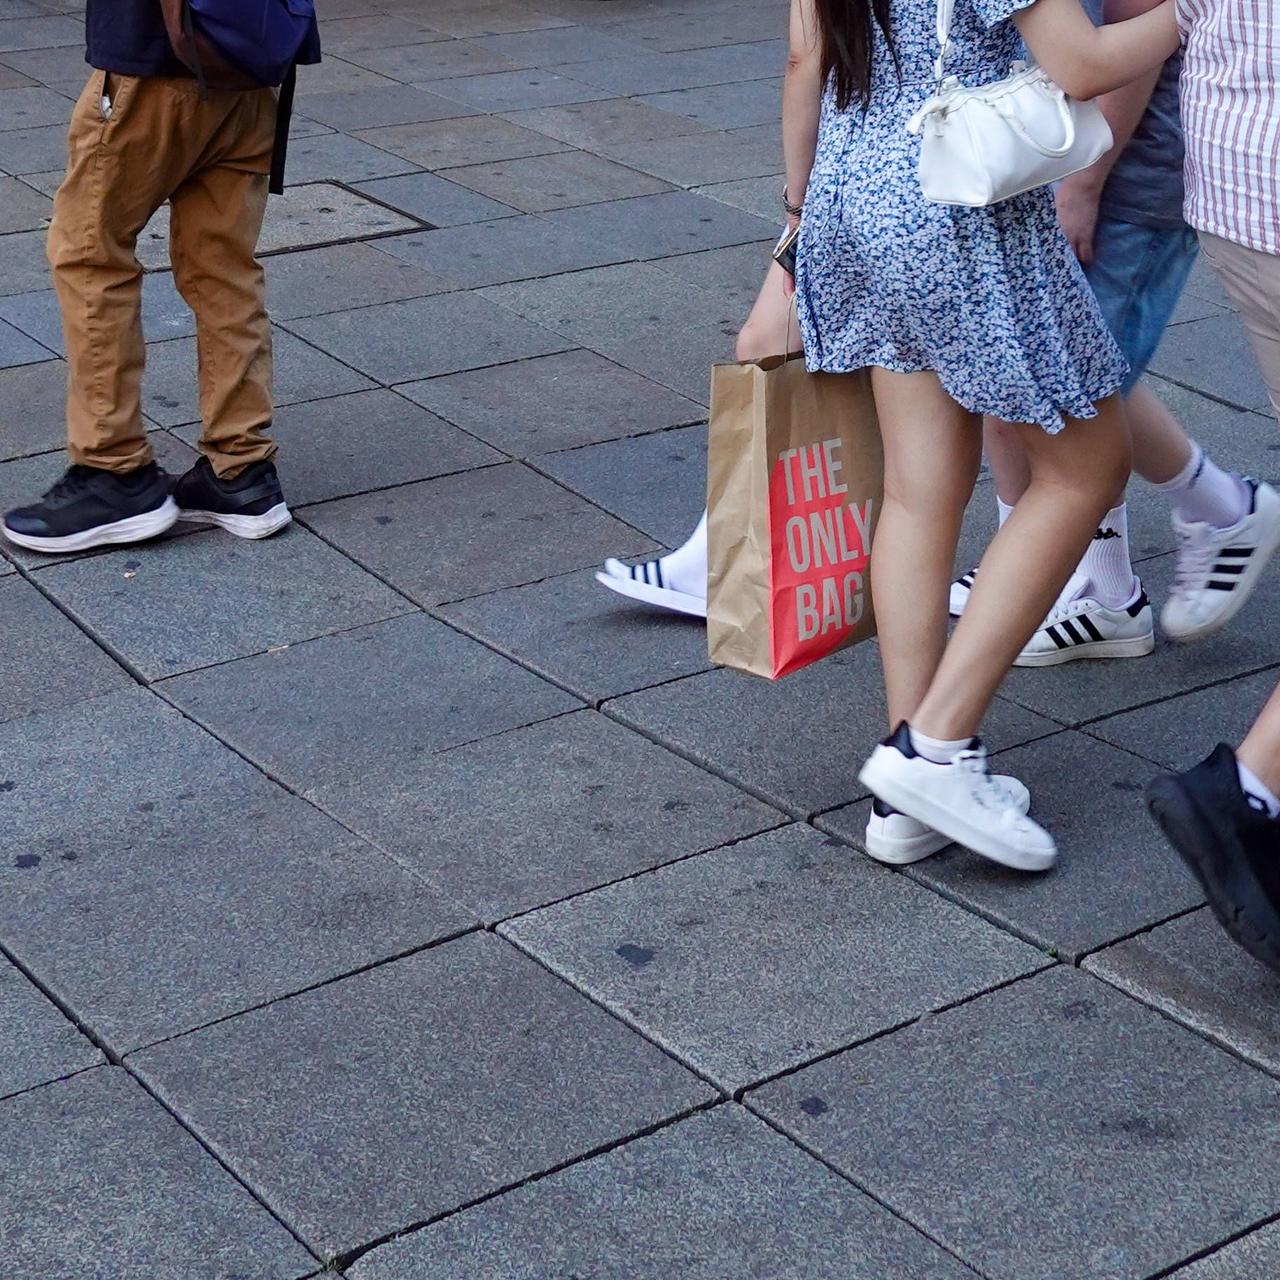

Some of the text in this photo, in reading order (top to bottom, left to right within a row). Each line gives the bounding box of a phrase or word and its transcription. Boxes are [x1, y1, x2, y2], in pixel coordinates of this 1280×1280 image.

[779, 437, 849, 506] THE
[785, 498, 873, 574] ONLY
[796, 571, 865, 642] BAG
